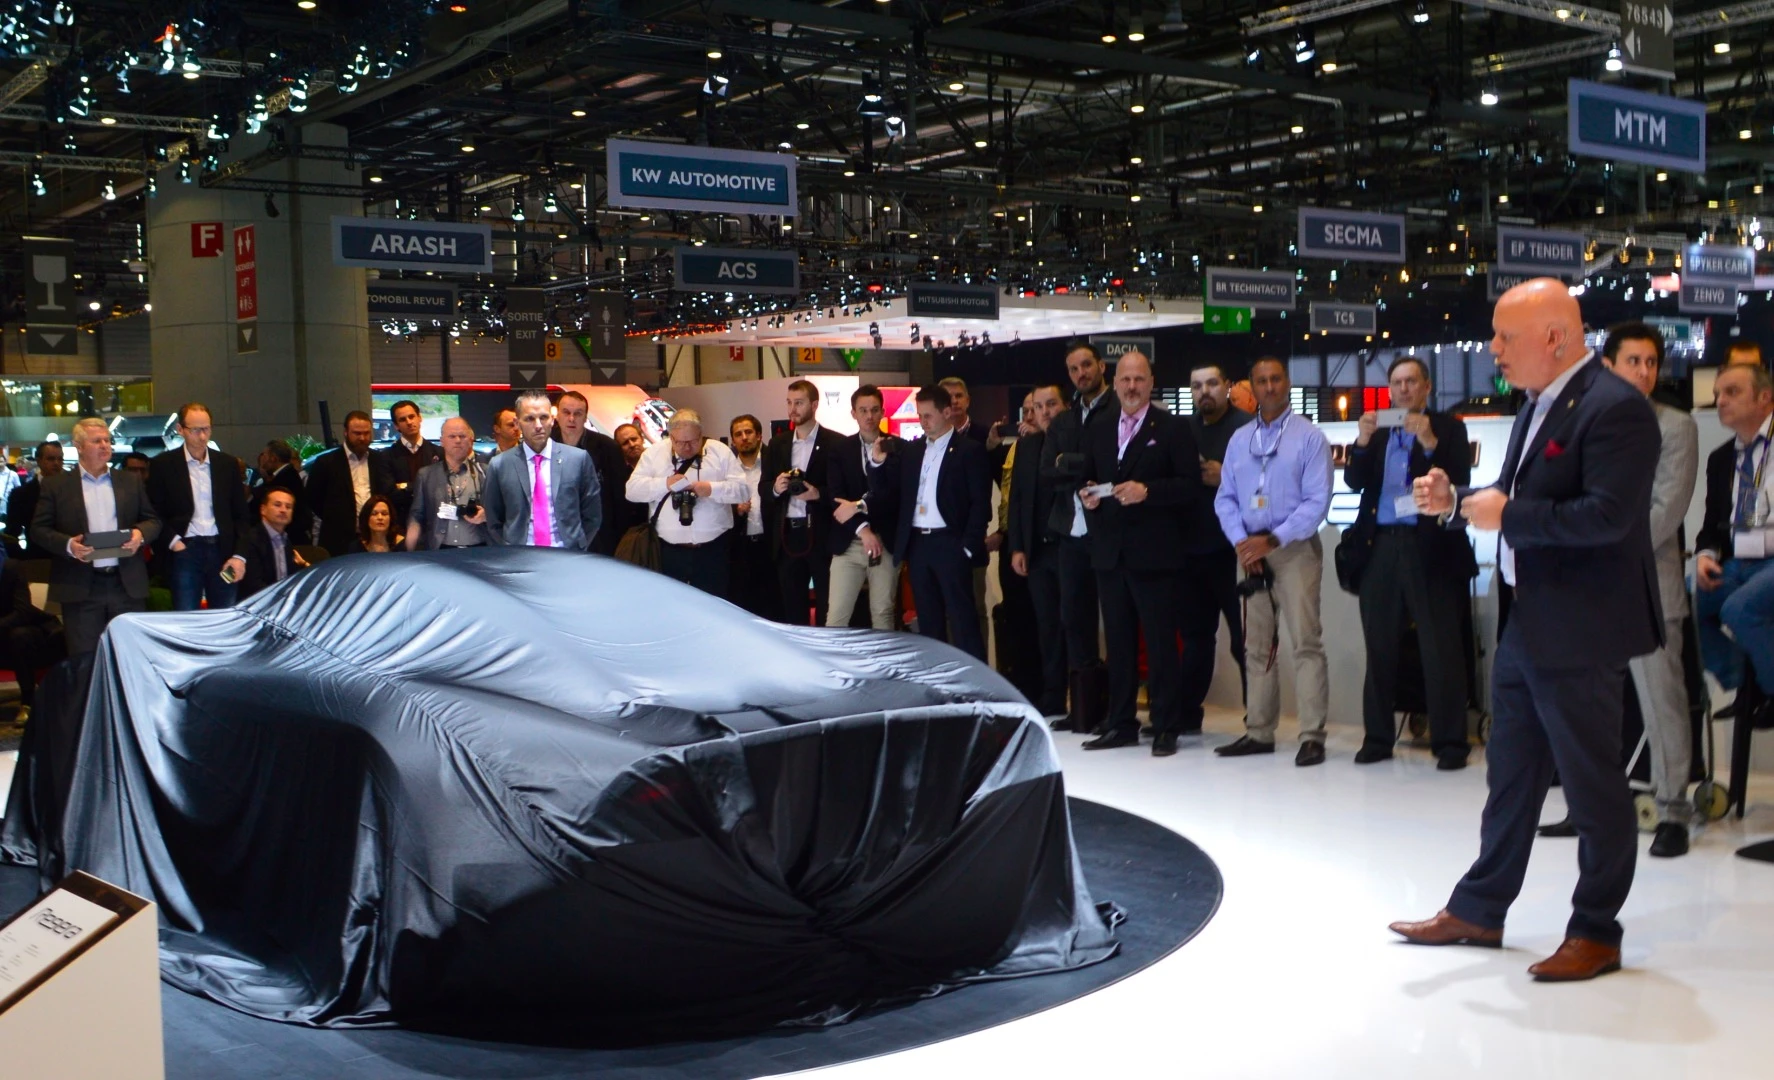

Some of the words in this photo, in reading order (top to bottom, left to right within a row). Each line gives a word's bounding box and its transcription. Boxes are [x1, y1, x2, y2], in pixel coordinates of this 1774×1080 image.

[1615, 107, 1666, 147] MTM
[632, 167, 661, 184] KW
[668, 170, 776, 192] AUTOMOTIVE
[200, 225, 216, 249] F
[1324, 223, 1383, 247] SECMA
[370, 233, 457, 257] ARASH
[1511, 240, 1525, 257] EP
[1529, 241, 1574, 261] TENDER
[718, 261, 757, 279] ACS
[1216, 281, 1227, 293] BR
[1693, 286, 1725, 304] ZENVO
[413, 295, 446, 306] REVUE
[918, 295, 959, 305] MITSUBISHI
[960, 297, 989, 307] MOTORS
[507, 312, 544, 322] SORTIE
[1334, 310, 1355, 325] TCS
[515, 329, 537, 339] EXIT
[546, 342, 556, 358] 8
[803, 347, 816, 361] 21
